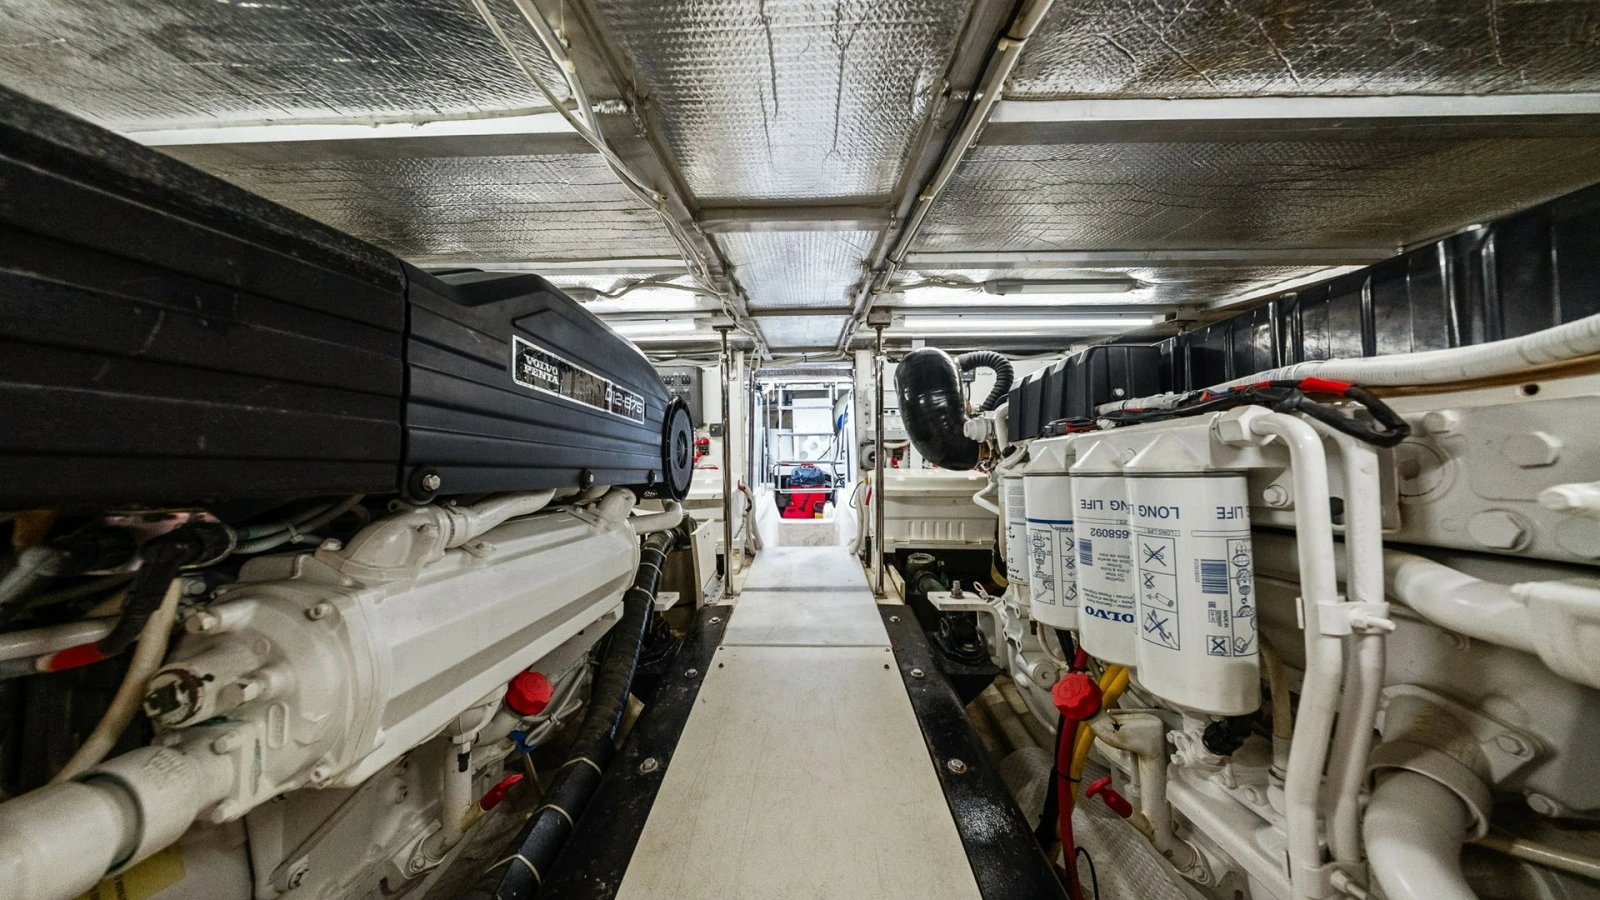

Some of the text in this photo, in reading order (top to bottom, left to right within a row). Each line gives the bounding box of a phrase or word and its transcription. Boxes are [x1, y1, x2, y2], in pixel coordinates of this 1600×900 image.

[524, 354, 558, 376] VOLVO
[523, 363, 560, 385] PENTA
[1080, 499, 1103, 510] LIFE
[1138, 505, 1179, 519] LONG
[1216, 506, 1243, 519] LIFE
[1090, 528, 1129, 539] 658092
